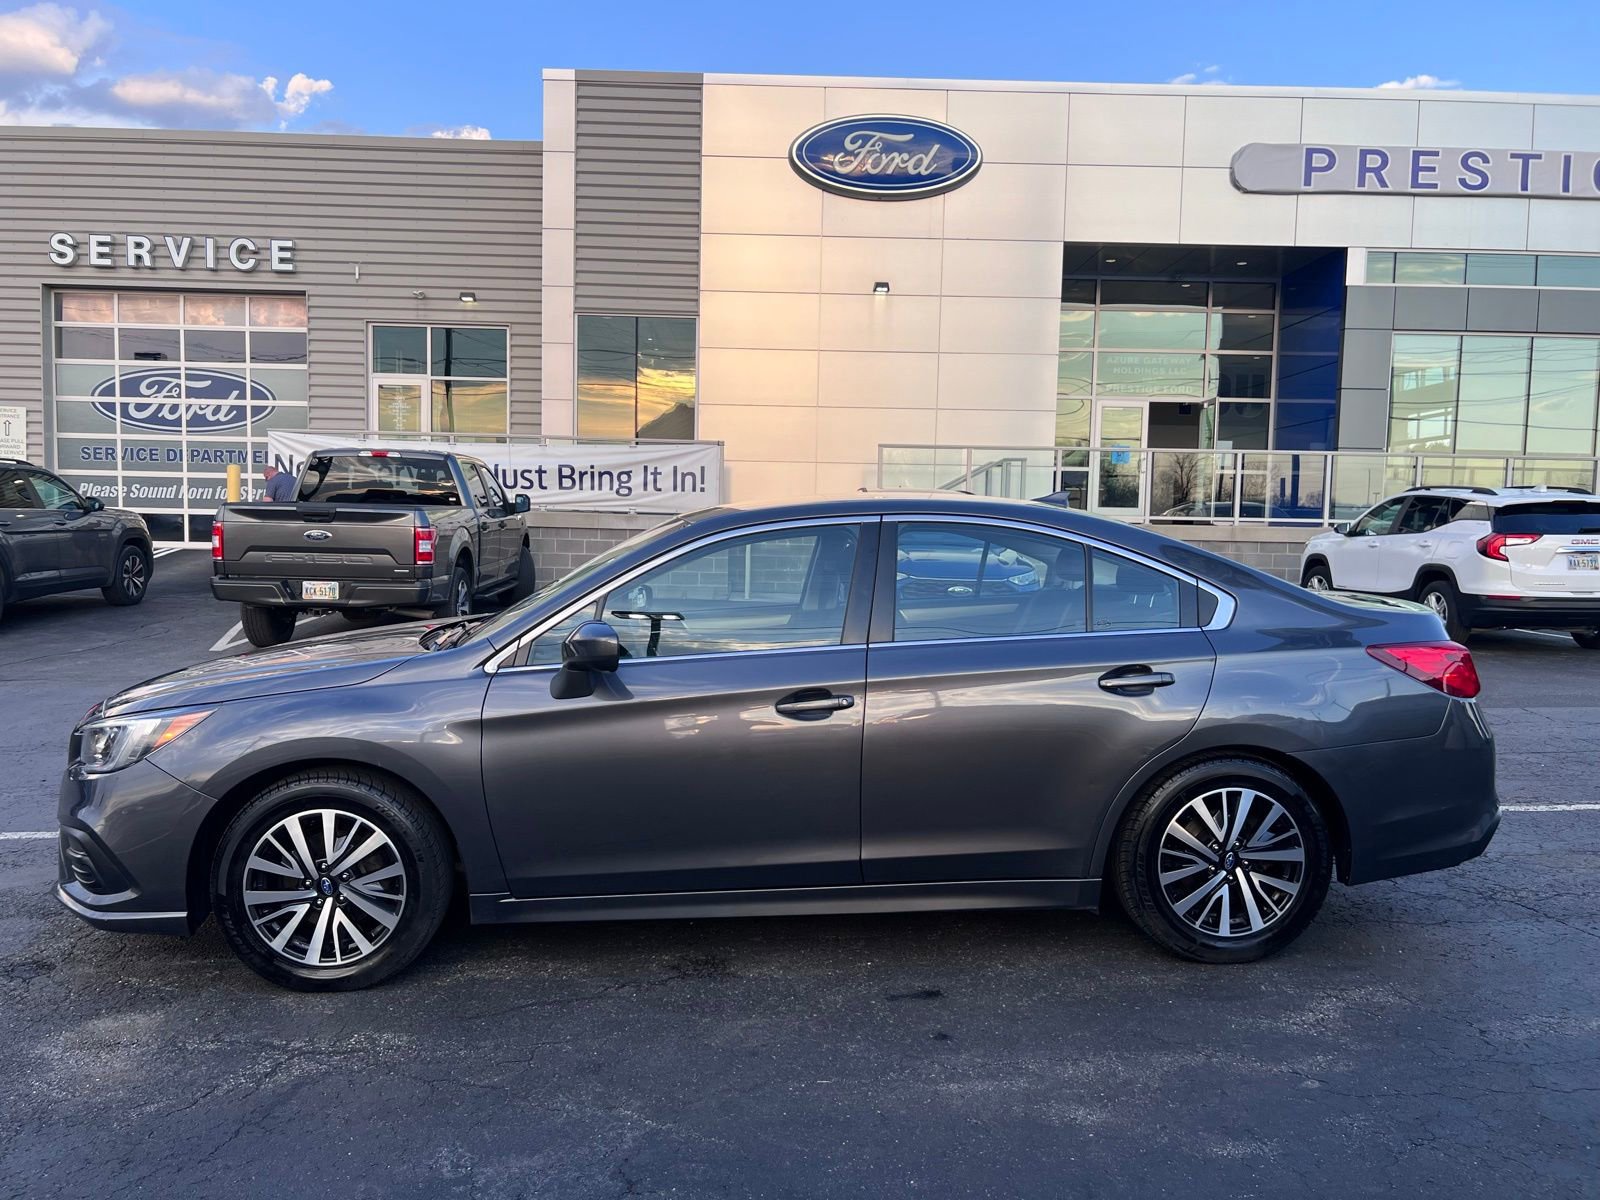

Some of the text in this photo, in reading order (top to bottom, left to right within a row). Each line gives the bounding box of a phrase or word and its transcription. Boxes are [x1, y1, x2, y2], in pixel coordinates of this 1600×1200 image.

[833, 131, 941, 176] Ford
[1301, 146, 1600, 194] PRESTI
[49, 232, 296, 272] SERVICE
[1113, 367, 1187, 375] HOLDINGS LLC
[128, 376, 240, 422] Ford
[1105, 383, 1193, 394] PRESTIGE FORD
[80, 446, 161, 462] SERVICE
[78, 482, 128, 497] Please
[129, 484, 177, 499] Sound
[214, 486, 228, 500] fo
[557, 464, 633, 497] Bring
[643, 465, 662, 492] It
[673, 465, 706, 493] In!
